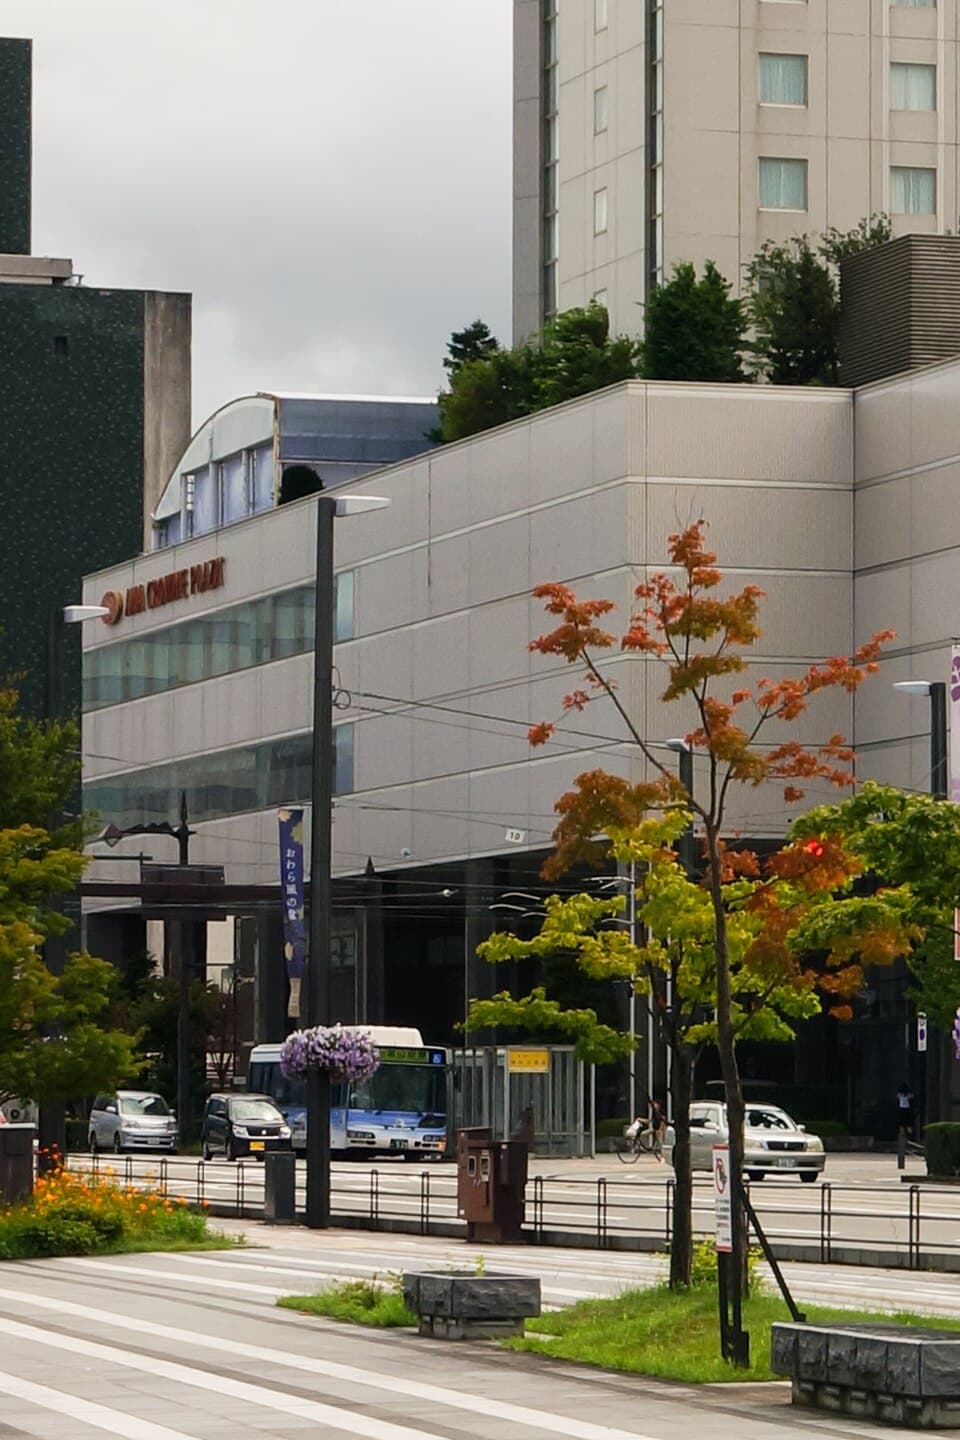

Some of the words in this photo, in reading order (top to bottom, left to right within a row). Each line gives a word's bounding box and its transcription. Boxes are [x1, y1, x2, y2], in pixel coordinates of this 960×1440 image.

[286, 848, 298, 920] おわら風の盆
